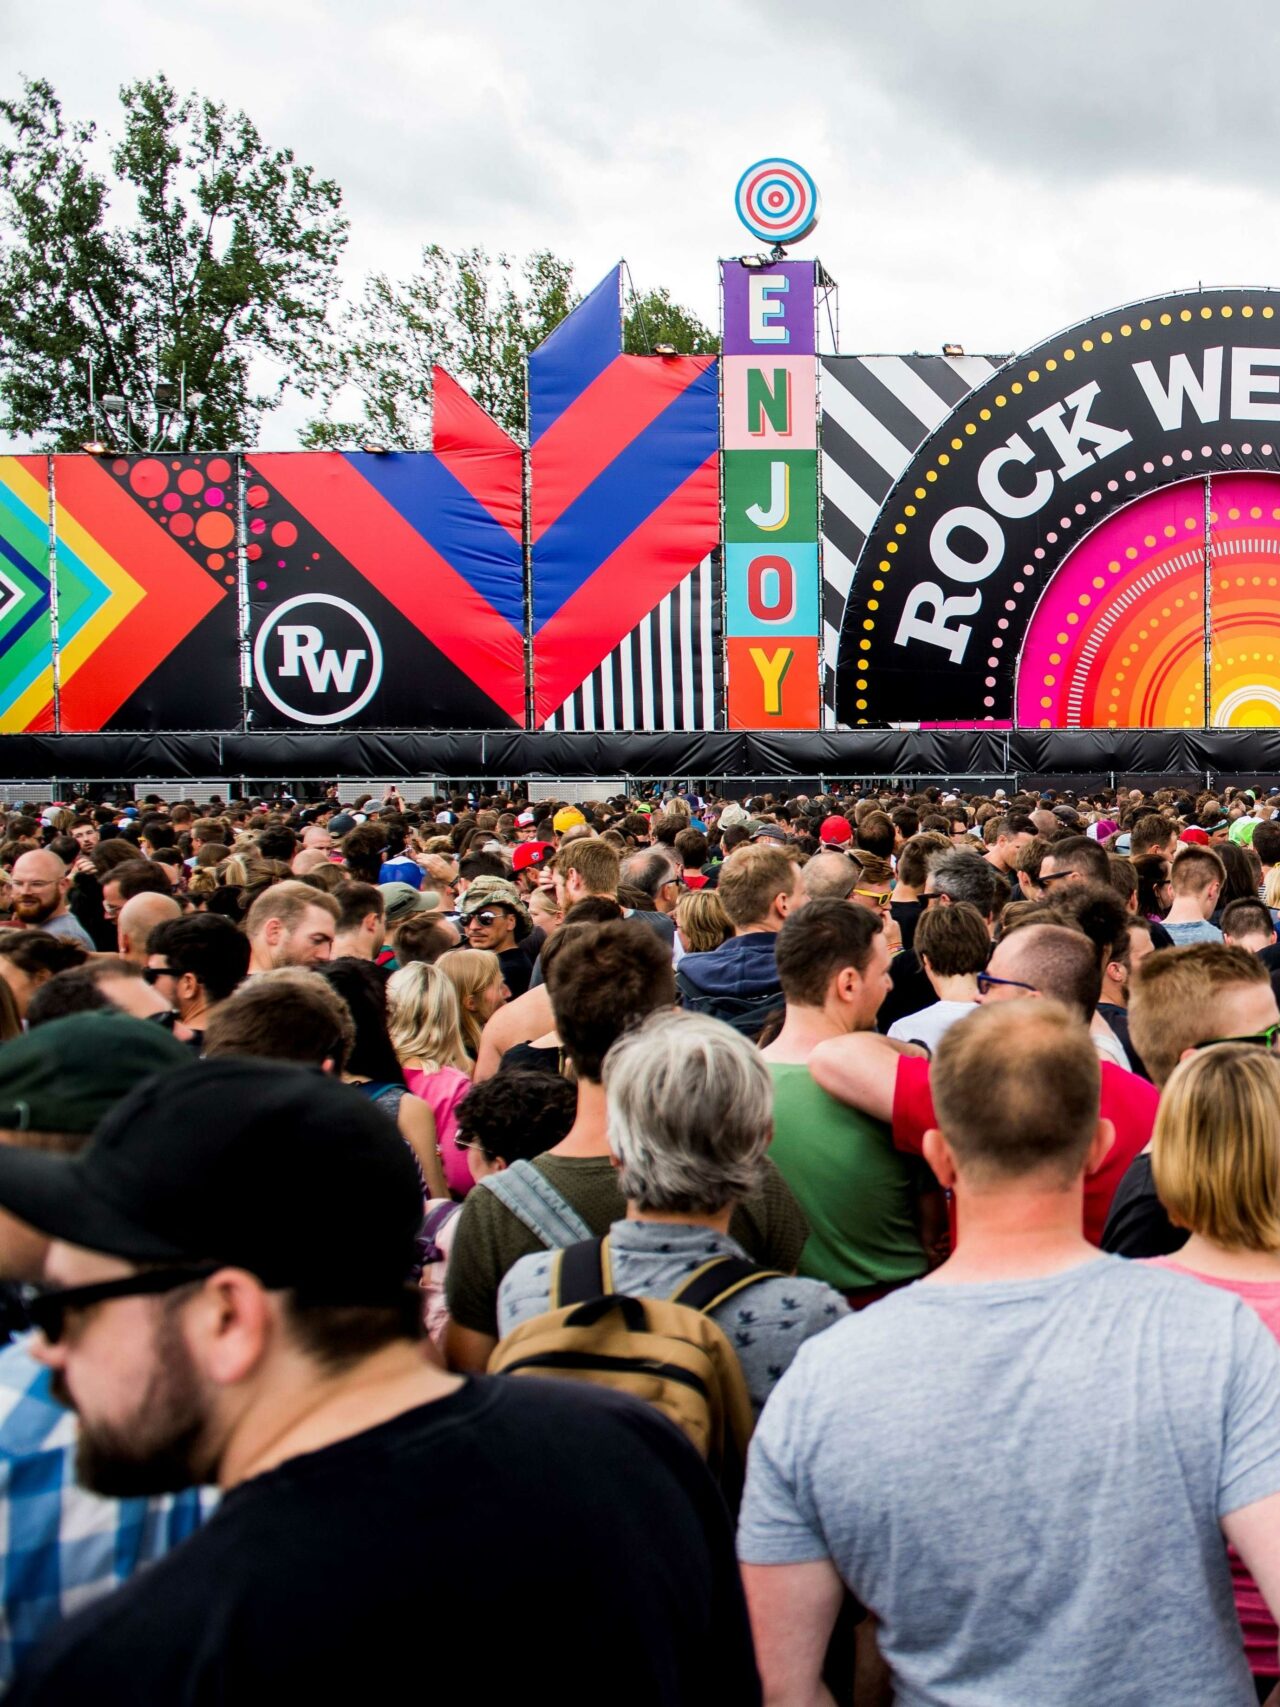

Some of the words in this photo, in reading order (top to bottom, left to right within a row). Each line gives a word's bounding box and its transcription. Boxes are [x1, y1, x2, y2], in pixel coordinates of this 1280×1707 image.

[746, 273, 796, 716] ENJOY
[894, 380, 1133, 665] ROCK
[278, 625, 367, 693] RW
